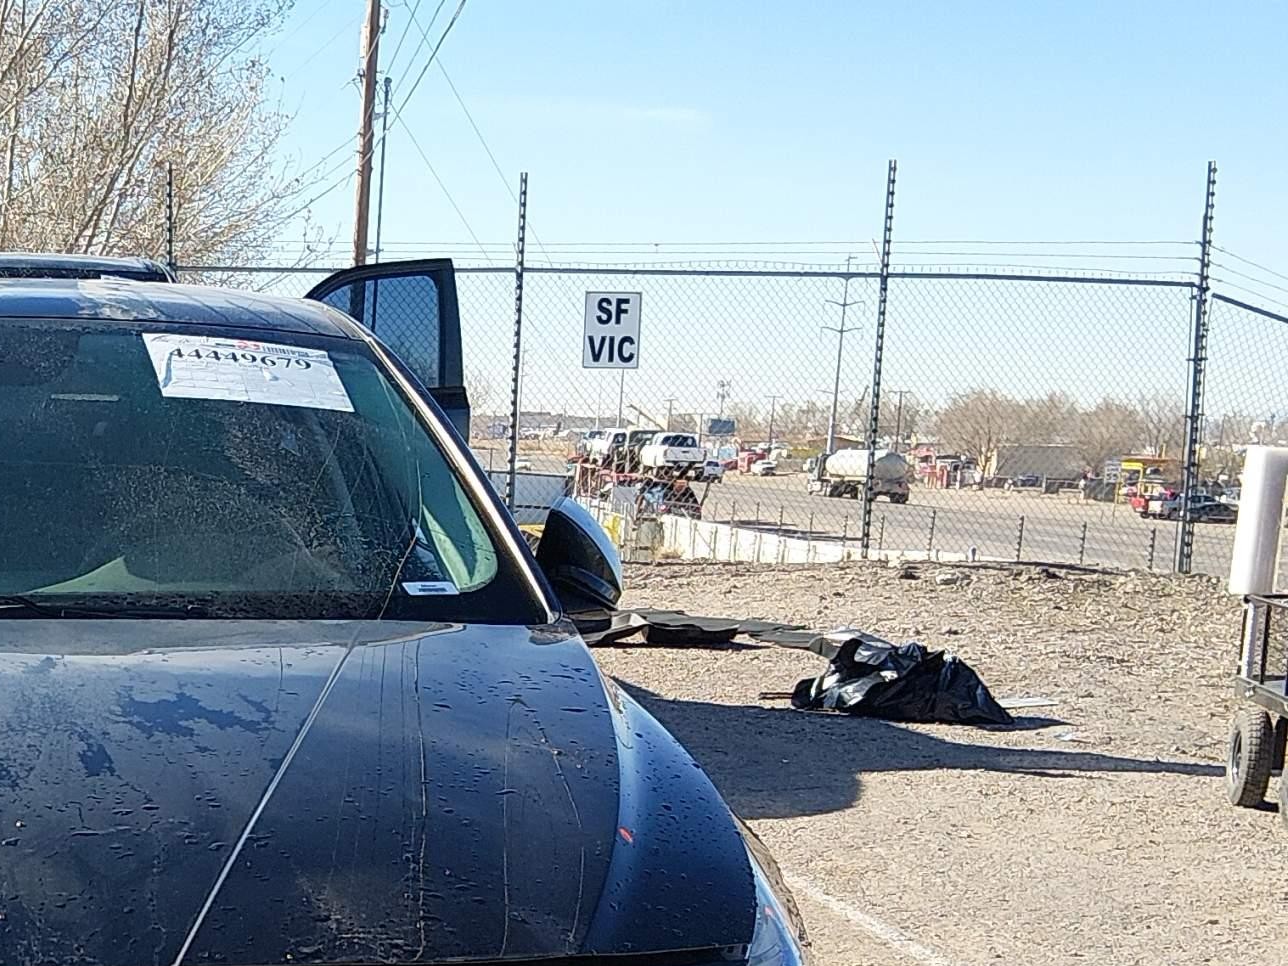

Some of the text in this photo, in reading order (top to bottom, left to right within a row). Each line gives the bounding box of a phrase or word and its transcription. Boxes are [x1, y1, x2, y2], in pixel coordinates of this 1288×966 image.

[596, 297, 631, 325] SF
[170, 347, 312, 370] 44449679
[588, 335, 636, 363] VIC
